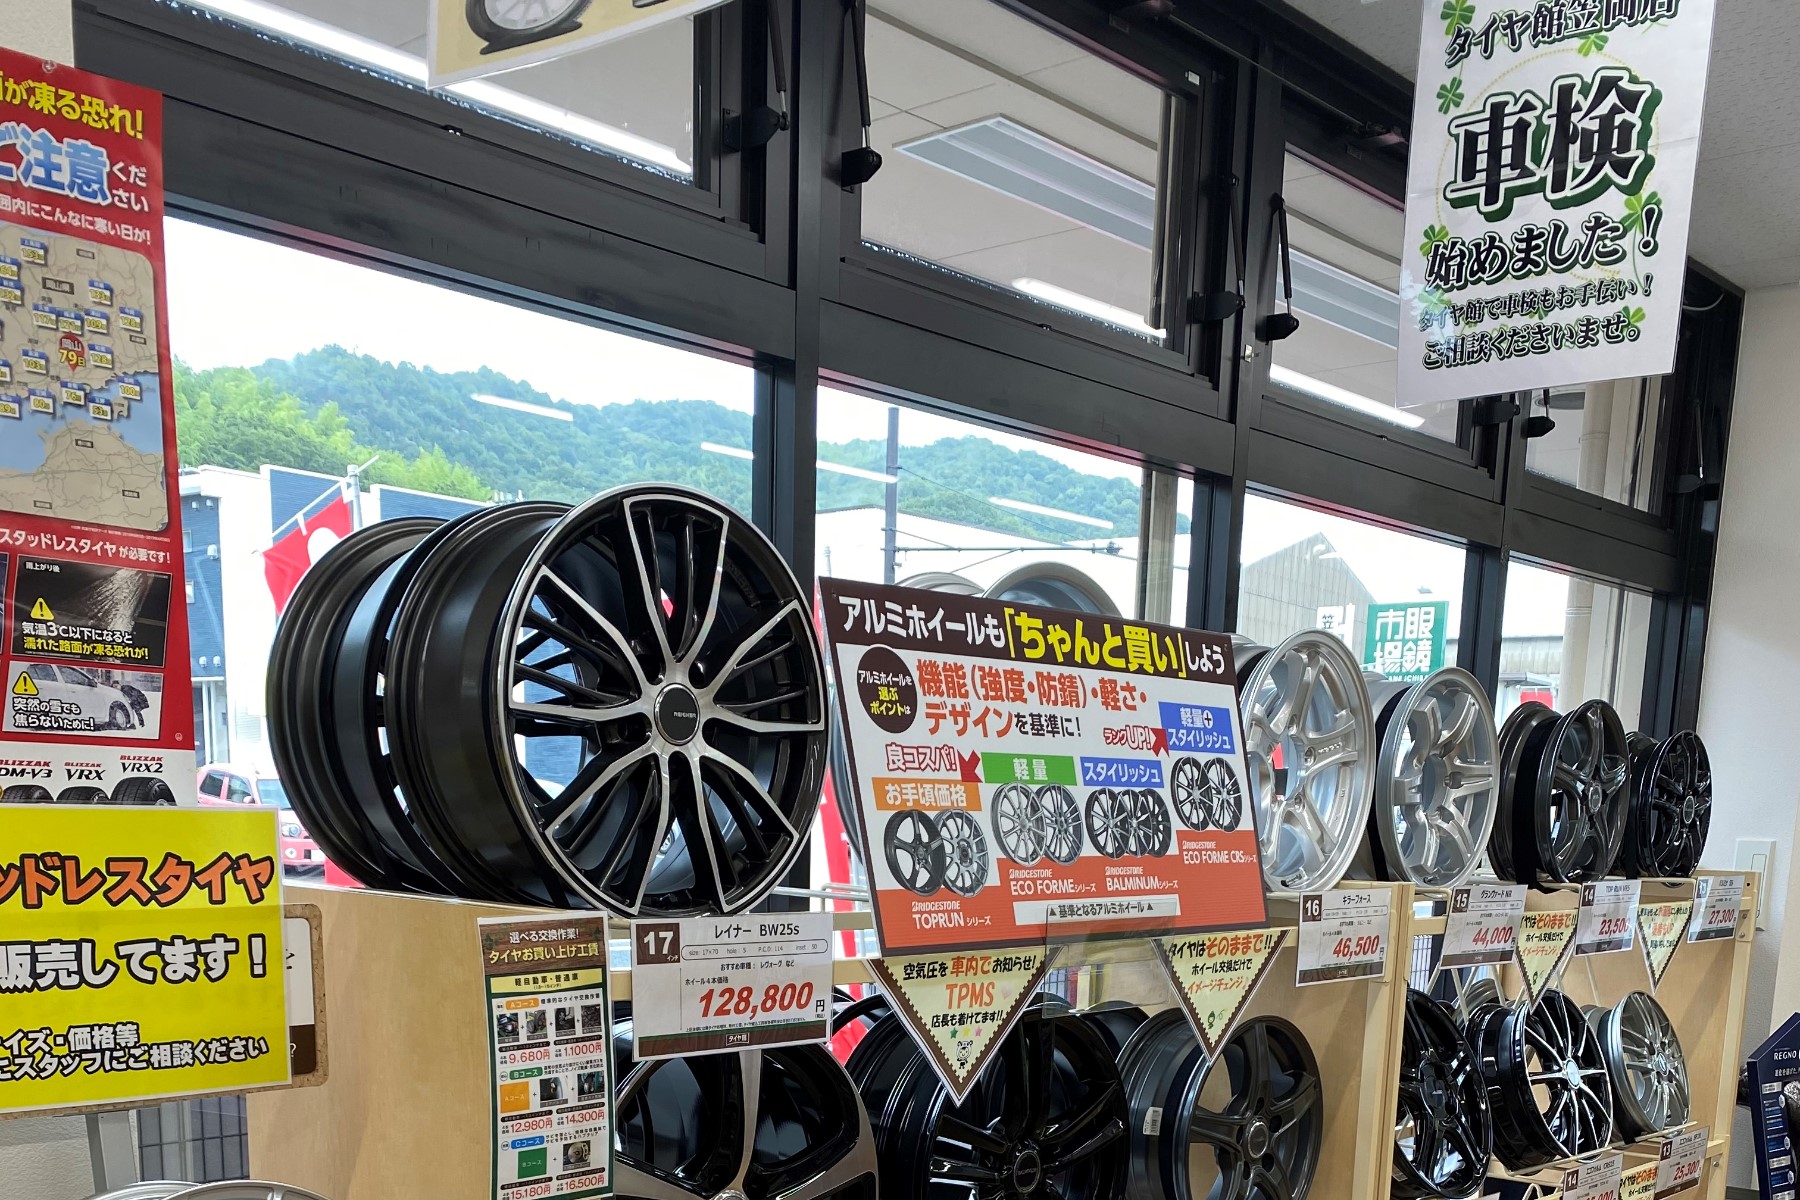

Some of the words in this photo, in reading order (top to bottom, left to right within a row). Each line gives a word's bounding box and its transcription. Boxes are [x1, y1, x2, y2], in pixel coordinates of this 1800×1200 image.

[0, 70, 143, 140] が凍る恐れ!
[1446, 67, 1660, 218] 車検
[1423, 313, 1641, 369] ご相談くださいませ。
[858, 670, 912, 686] アルミホイールを
[878, 686, 899, 700] 選ぶ
[13, 698, 81, 714] 突然の雪でも
[870, 701, 911, 716] ポイントは
[1168, 729, 1231, 749] スタイリッシュ
[65, 769, 106, 781] VRX
[121, 762, 163, 774] VRX2
[1013, 758, 1048, 780] 軽量
[1084, 762, 1161, 783] スタイリッシュ
[884, 783, 967, 807] お手頃価格
[1183, 851, 1199, 864] ECO
[1202, 851, 1229, 863] FORME
[1009, 869, 1053, 880] BRIDGESTONE
[1105, 866, 1144, 876] BRIDGESTONE
[1010, 881, 1034, 896] ECO
[1584, 888, 1595, 901] 14
[911, 901, 961, 912] BRIDGESTONE
[1306, 900, 1319, 916] 16
[1456, 893, 1467, 908] 15
[912, 912, 965, 930] TOPRUN
[966, 916, 991, 927] シリーズ
[1708, 908, 1735, 925] 27,300
[714, 924, 752, 939] レイナー
[759, 924, 800, 936] BW25s
[1472, 926, 1513, 948] 44,000
[643, 931, 674, 955] 17
[1332, 935, 1380, 961] 46,500
[489, 943, 600, 964] タイヤお買い上げ工賃
[1191, 959, 1252, 975] ホイール交換だけで
[699, 982, 814, 1020] 128,800
[815, 999, 825, 1013] 円
[945, 981, 996, 1010] TPMS
[1773, 1050, 1797, 1060] REGNO
[1662, 1146, 1671, 1158] 13
[1672, 1159, 1700, 1182] 25,300
[1567, 1174, 1578, 1187] 14
